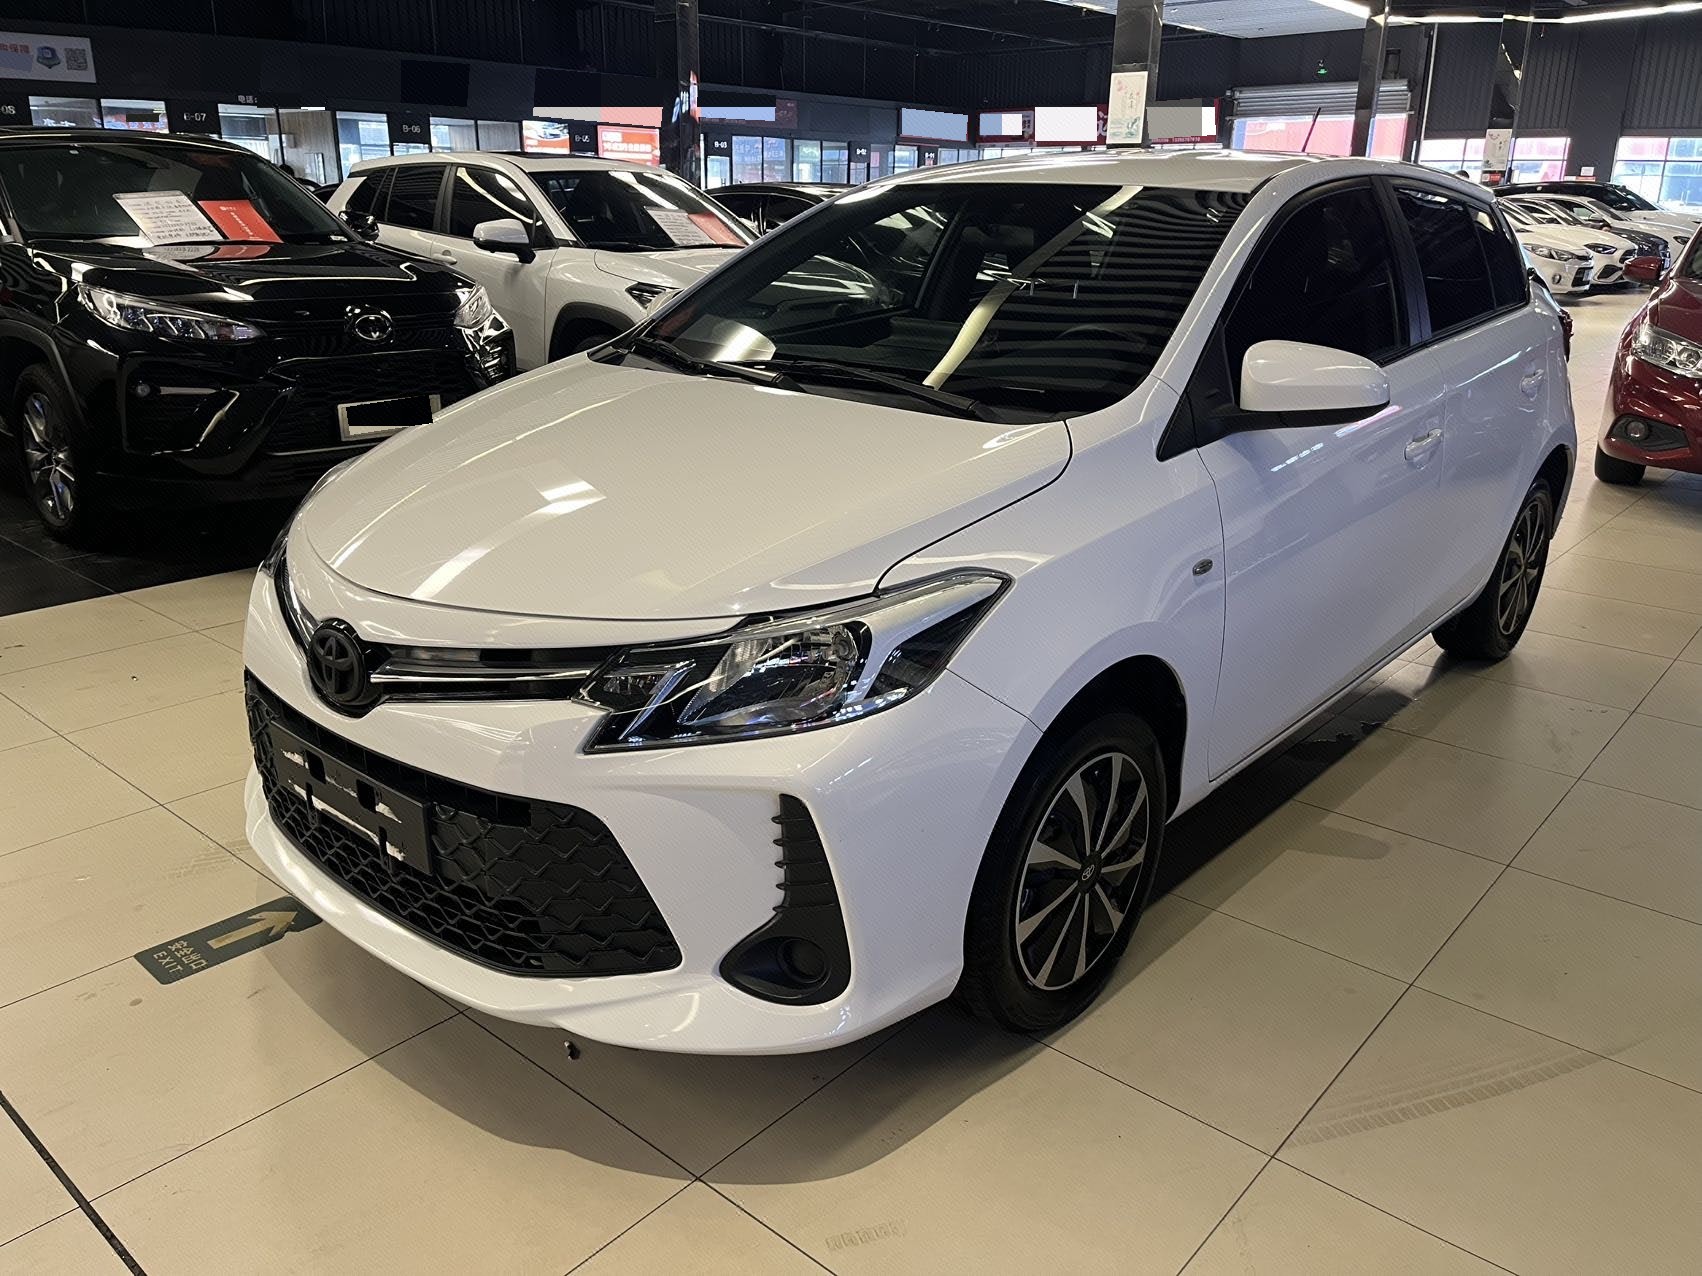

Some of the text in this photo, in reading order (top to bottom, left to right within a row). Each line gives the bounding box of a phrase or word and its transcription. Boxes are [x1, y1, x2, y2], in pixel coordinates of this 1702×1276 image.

[183, 112, 207, 122] B-07
[402, 124, 421, 133] B-06
[153, 951, 184, 973] EXIT
[167, 940, 208, 970] 安全出口
